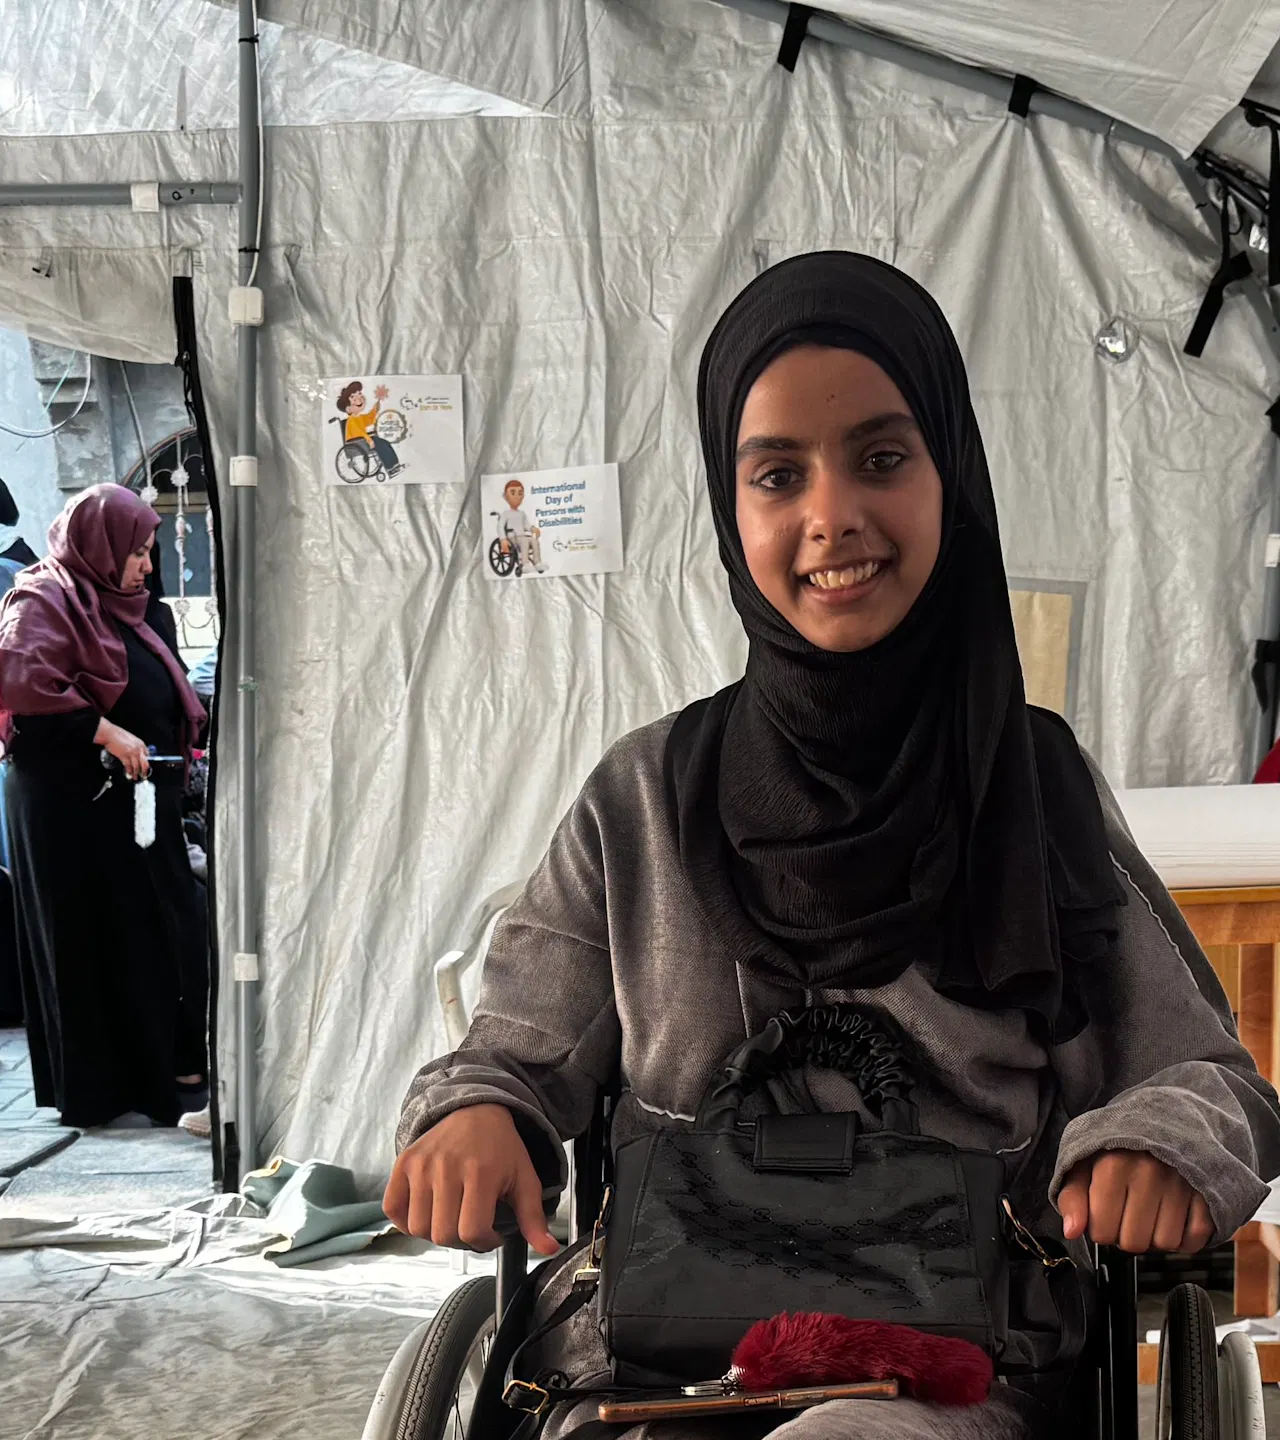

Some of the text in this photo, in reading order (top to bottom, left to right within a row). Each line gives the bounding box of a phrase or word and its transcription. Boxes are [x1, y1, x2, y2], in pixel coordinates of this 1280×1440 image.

[531, 480, 586, 494] International
[545, 493, 573, 505] Day of
